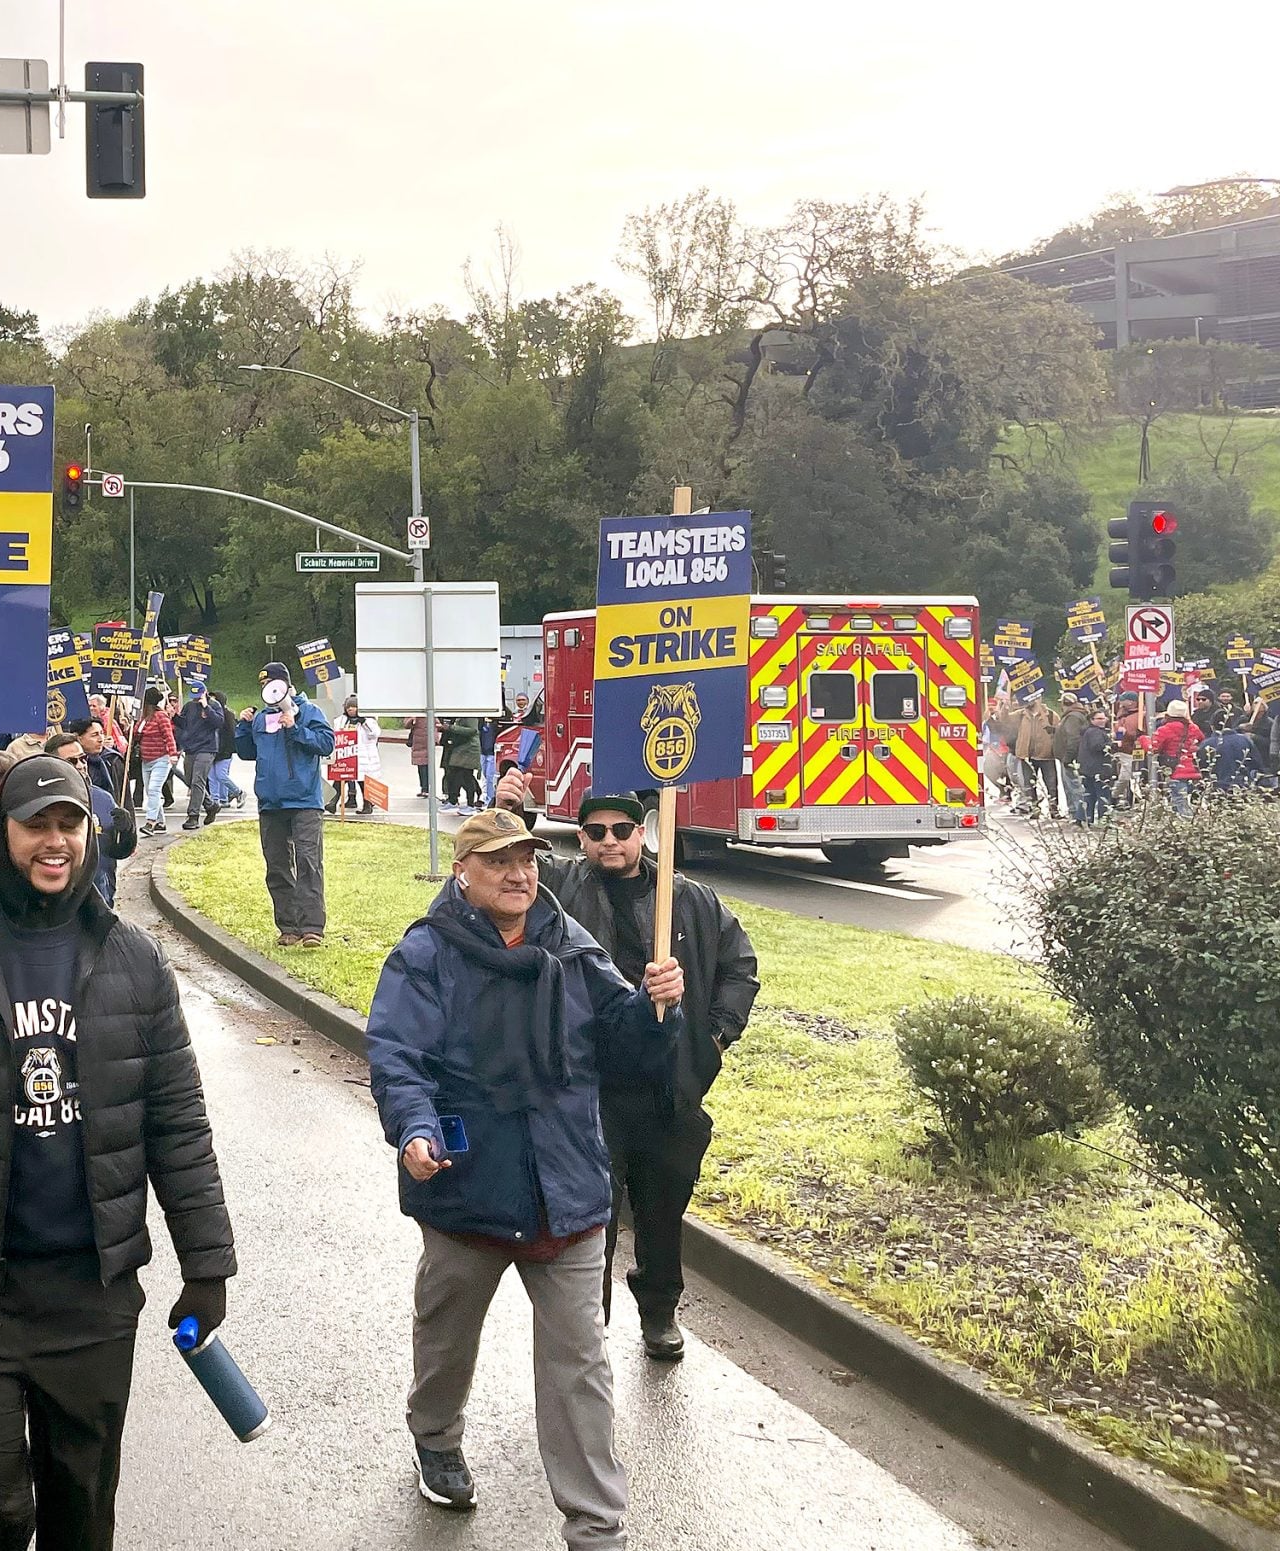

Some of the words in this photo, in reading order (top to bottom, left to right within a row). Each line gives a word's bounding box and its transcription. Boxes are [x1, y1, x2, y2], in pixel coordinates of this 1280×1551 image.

[607, 525, 746, 560] TEAMSTERS
[304, 558, 326, 567] Schultz
[328, 558, 355, 567] Memorial
[357, 558, 374, 567] Drive
[625, 560, 687, 588] LOCAL
[690, 556, 728, 584] 856
[659, 606, 693, 629] ON
[608, 627, 737, 668] STRIKE
[816, 643, 848, 656] SAN
[853, 643, 913, 656] RAFAEL
[97, 658, 140, 668] STRIKE
[304, 655, 332, 667] STRIKE
[759, 729, 787, 739] 1537351
[827, 728, 860, 741] FIRE
[868, 728, 907, 740] DEPT
[940, 727, 952, 738] M
[953, 726, 967, 738] 57
[655, 738, 685, 757] 856
